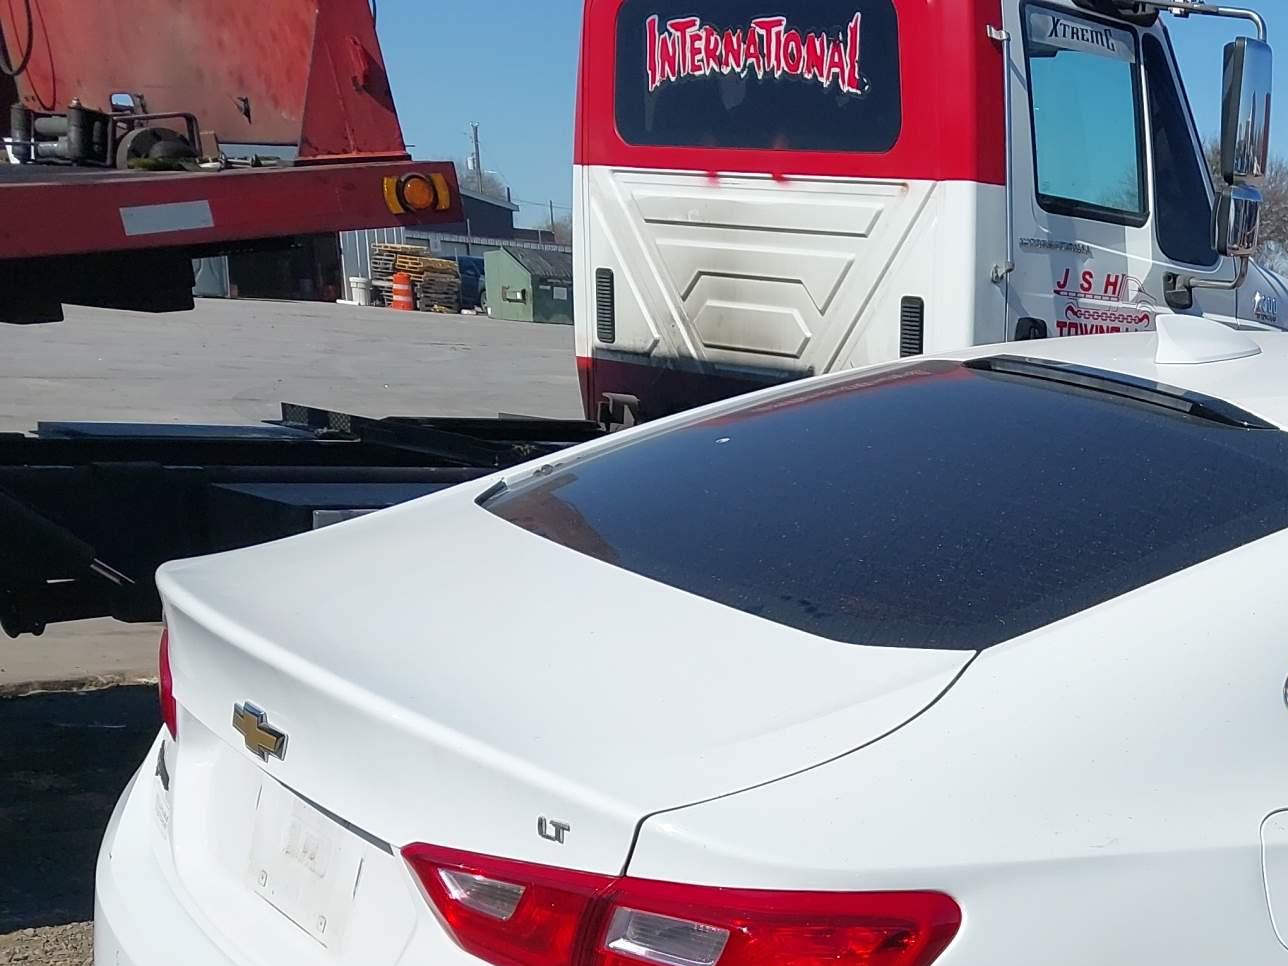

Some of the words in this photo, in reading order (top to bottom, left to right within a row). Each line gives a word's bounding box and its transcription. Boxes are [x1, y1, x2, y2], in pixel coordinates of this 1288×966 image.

[1048, 16, 1115, 52] XTREME
[646, 12, 867, 94] INTERNATIONAL
[537, 816, 570, 844] LT
